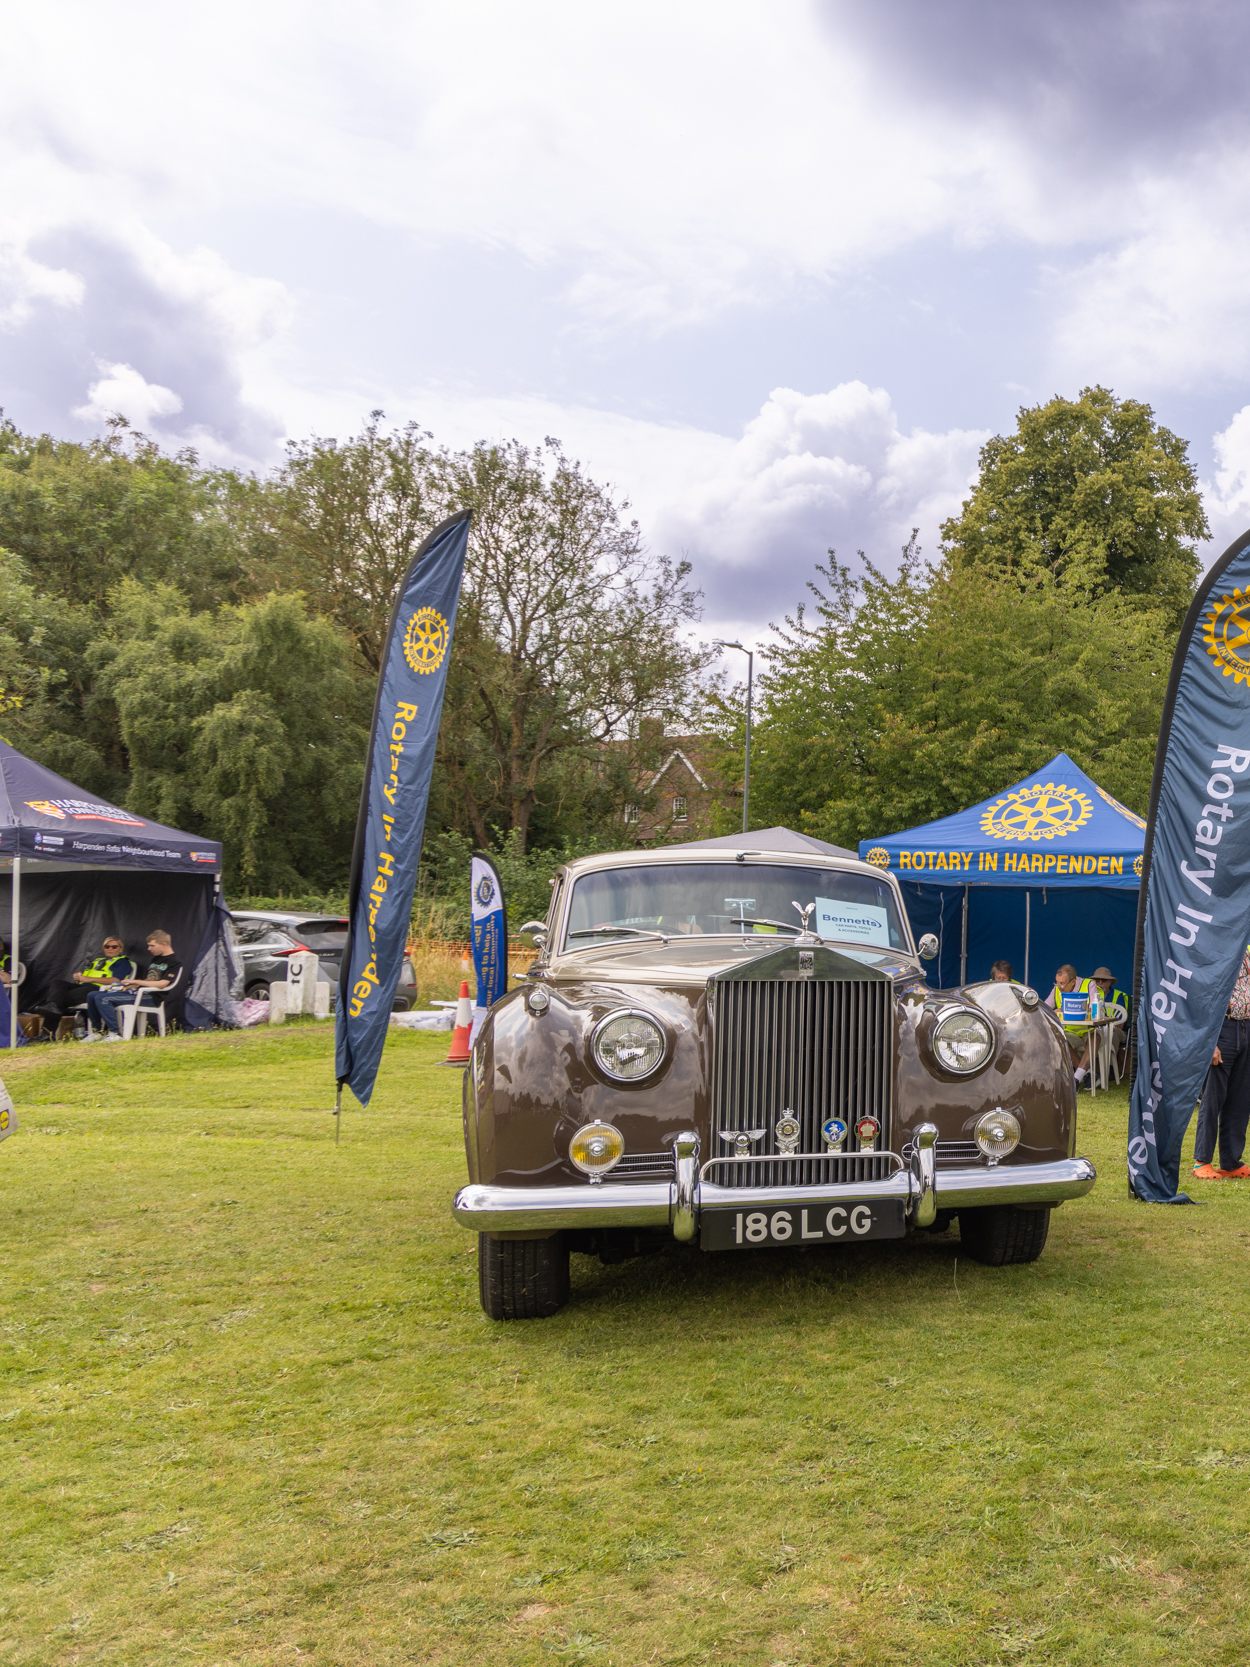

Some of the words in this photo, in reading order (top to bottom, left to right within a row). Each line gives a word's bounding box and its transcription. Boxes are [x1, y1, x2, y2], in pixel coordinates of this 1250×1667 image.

[383, 700, 418, 806] Rotary
[1025, 788, 1069, 800] ROTARY
[993, 821, 1073, 837] INTERNATIONAL
[166, 850, 182, 859] Team
[899, 851, 973, 871] ROTARY
[979, 852, 998, 872] IN
[1004, 853, 1124, 875] HARPENDEN
[822, 914, 877, 928] Bennetts
[1169, 902, 1214, 948] In
[482, 933, 491, 953] help
[481, 955, 489, 965] to
[486, 967, 495, 987] local
[735, 1210, 793, 1244] 186
[801, 1205, 872, 1240] LCG
